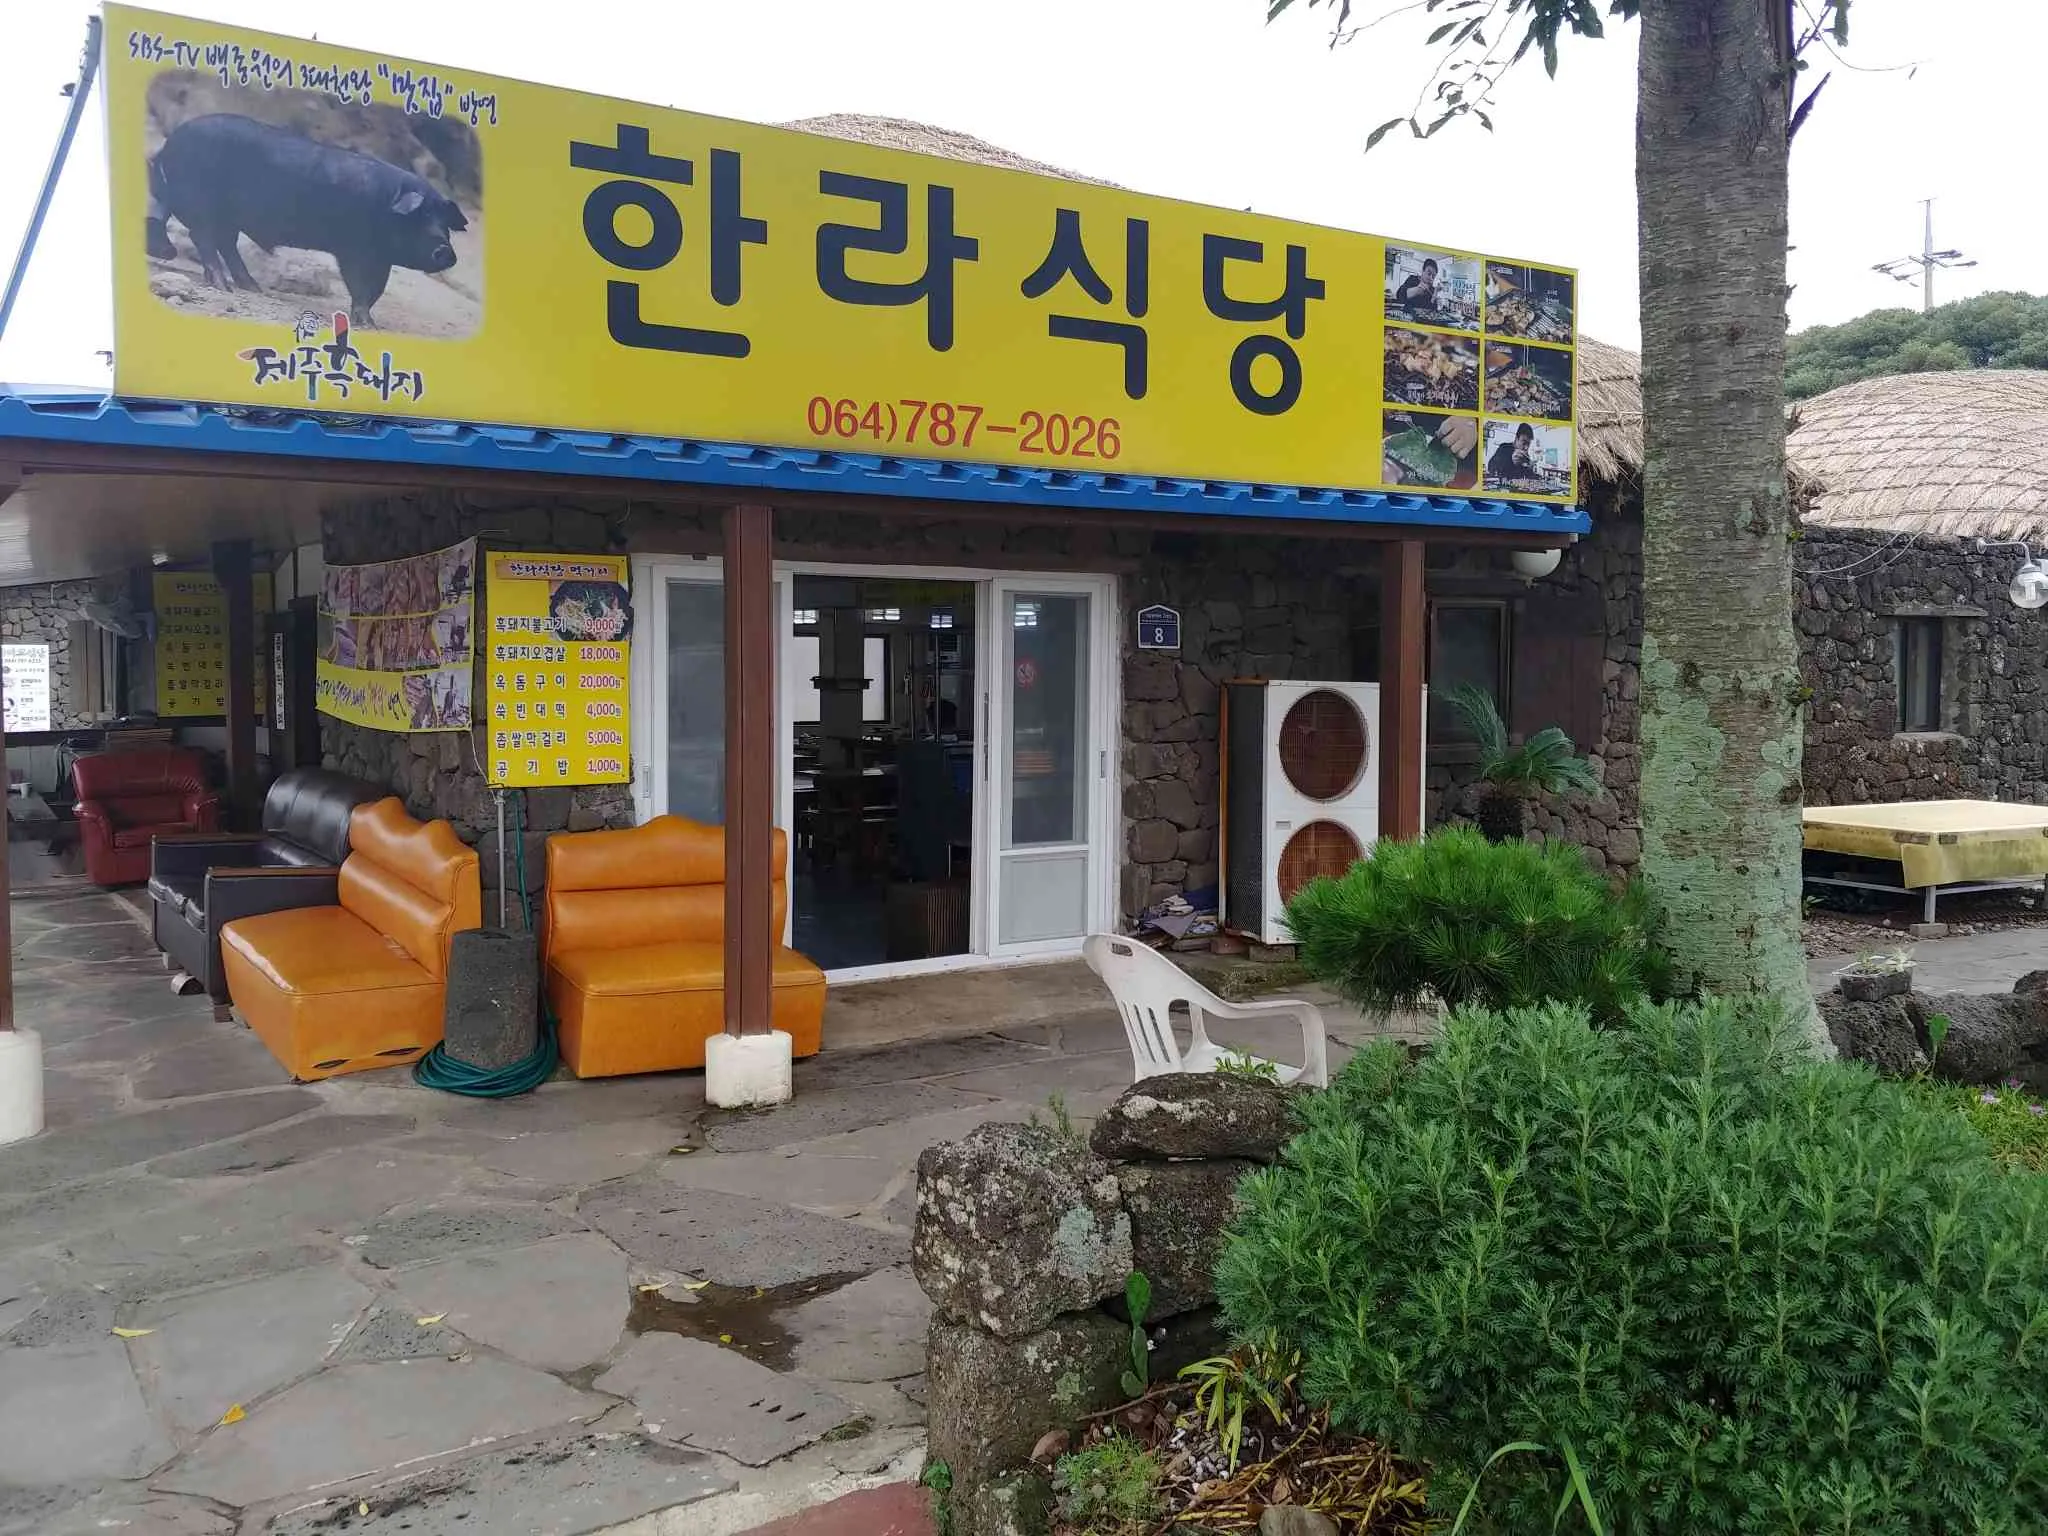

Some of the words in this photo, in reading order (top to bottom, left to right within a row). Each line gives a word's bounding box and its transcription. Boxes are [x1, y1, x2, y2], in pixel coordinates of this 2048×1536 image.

[129, 31, 200, 67] SBS-TV
[206, 43, 293, 89] 백종원의
[300, 64, 373, 104] 3대천왕
[459, 90, 498, 126] 방영
[570, 123, 1326, 416] 한라식당
[807, 396, 1122, 460] 064)787-2026
[509, 563, 565, 577] 한라식당
[569, 564, 608, 577] 먹거리
[495, 616, 567, 633] 흑돼지불고기
[1155, 627, 1164, 643] 8
[495, 645, 566, 662] 흑돼지오겹살
